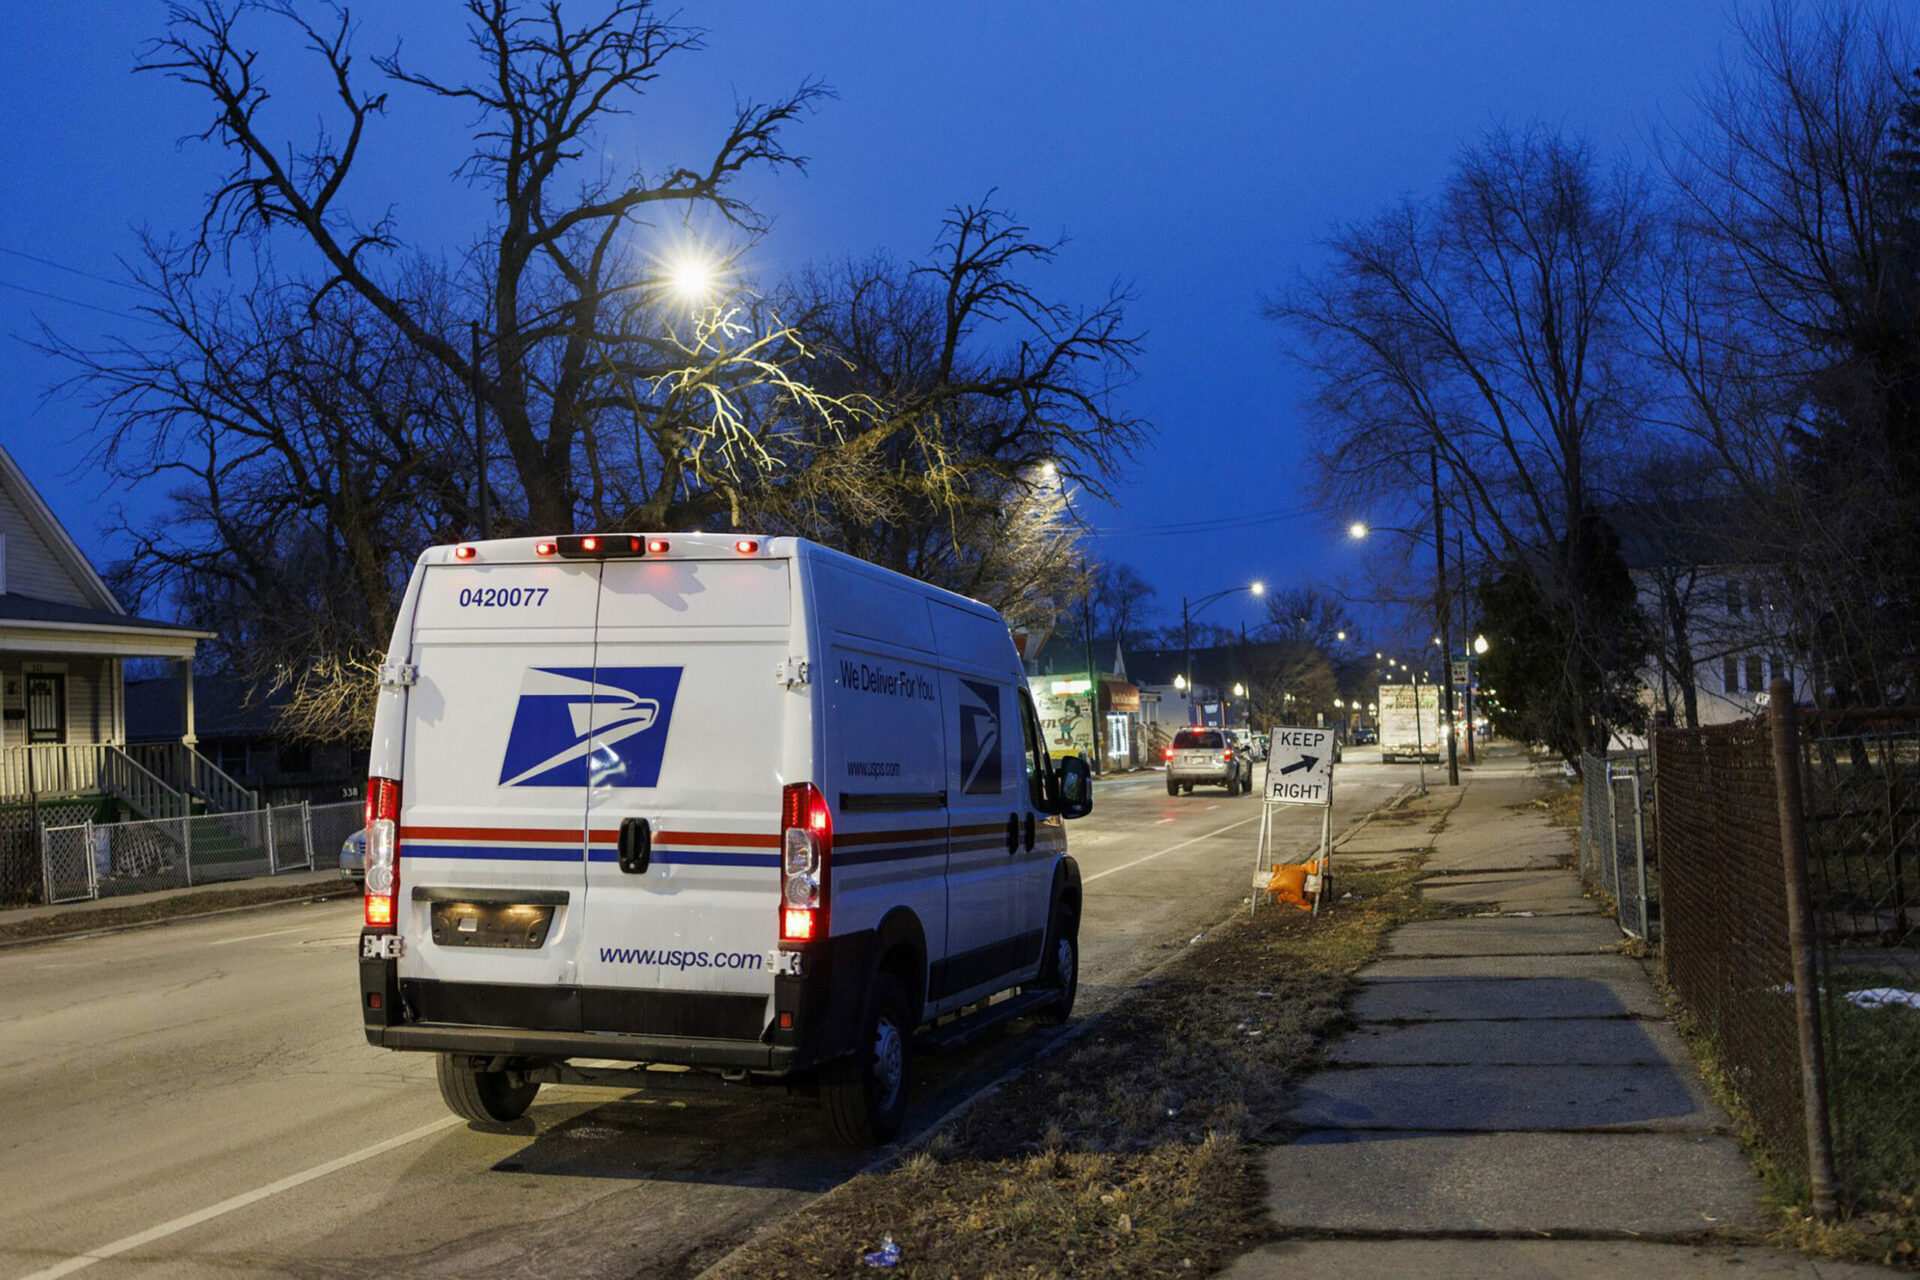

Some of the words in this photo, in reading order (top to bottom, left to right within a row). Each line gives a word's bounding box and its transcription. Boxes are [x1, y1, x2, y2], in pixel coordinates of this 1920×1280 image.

[460, 588, 549, 607] 0420077
[840, 661, 859, 691] We
[861, 664, 897, 696] Deliver
[899, 672, 916, 699] For
[1281, 731, 1325, 747] KEEP
[847, 761, 900, 780] www.usps.com
[1273, 783, 1322, 799] RIGHT
[600, 947, 762, 971] www.usps.com
